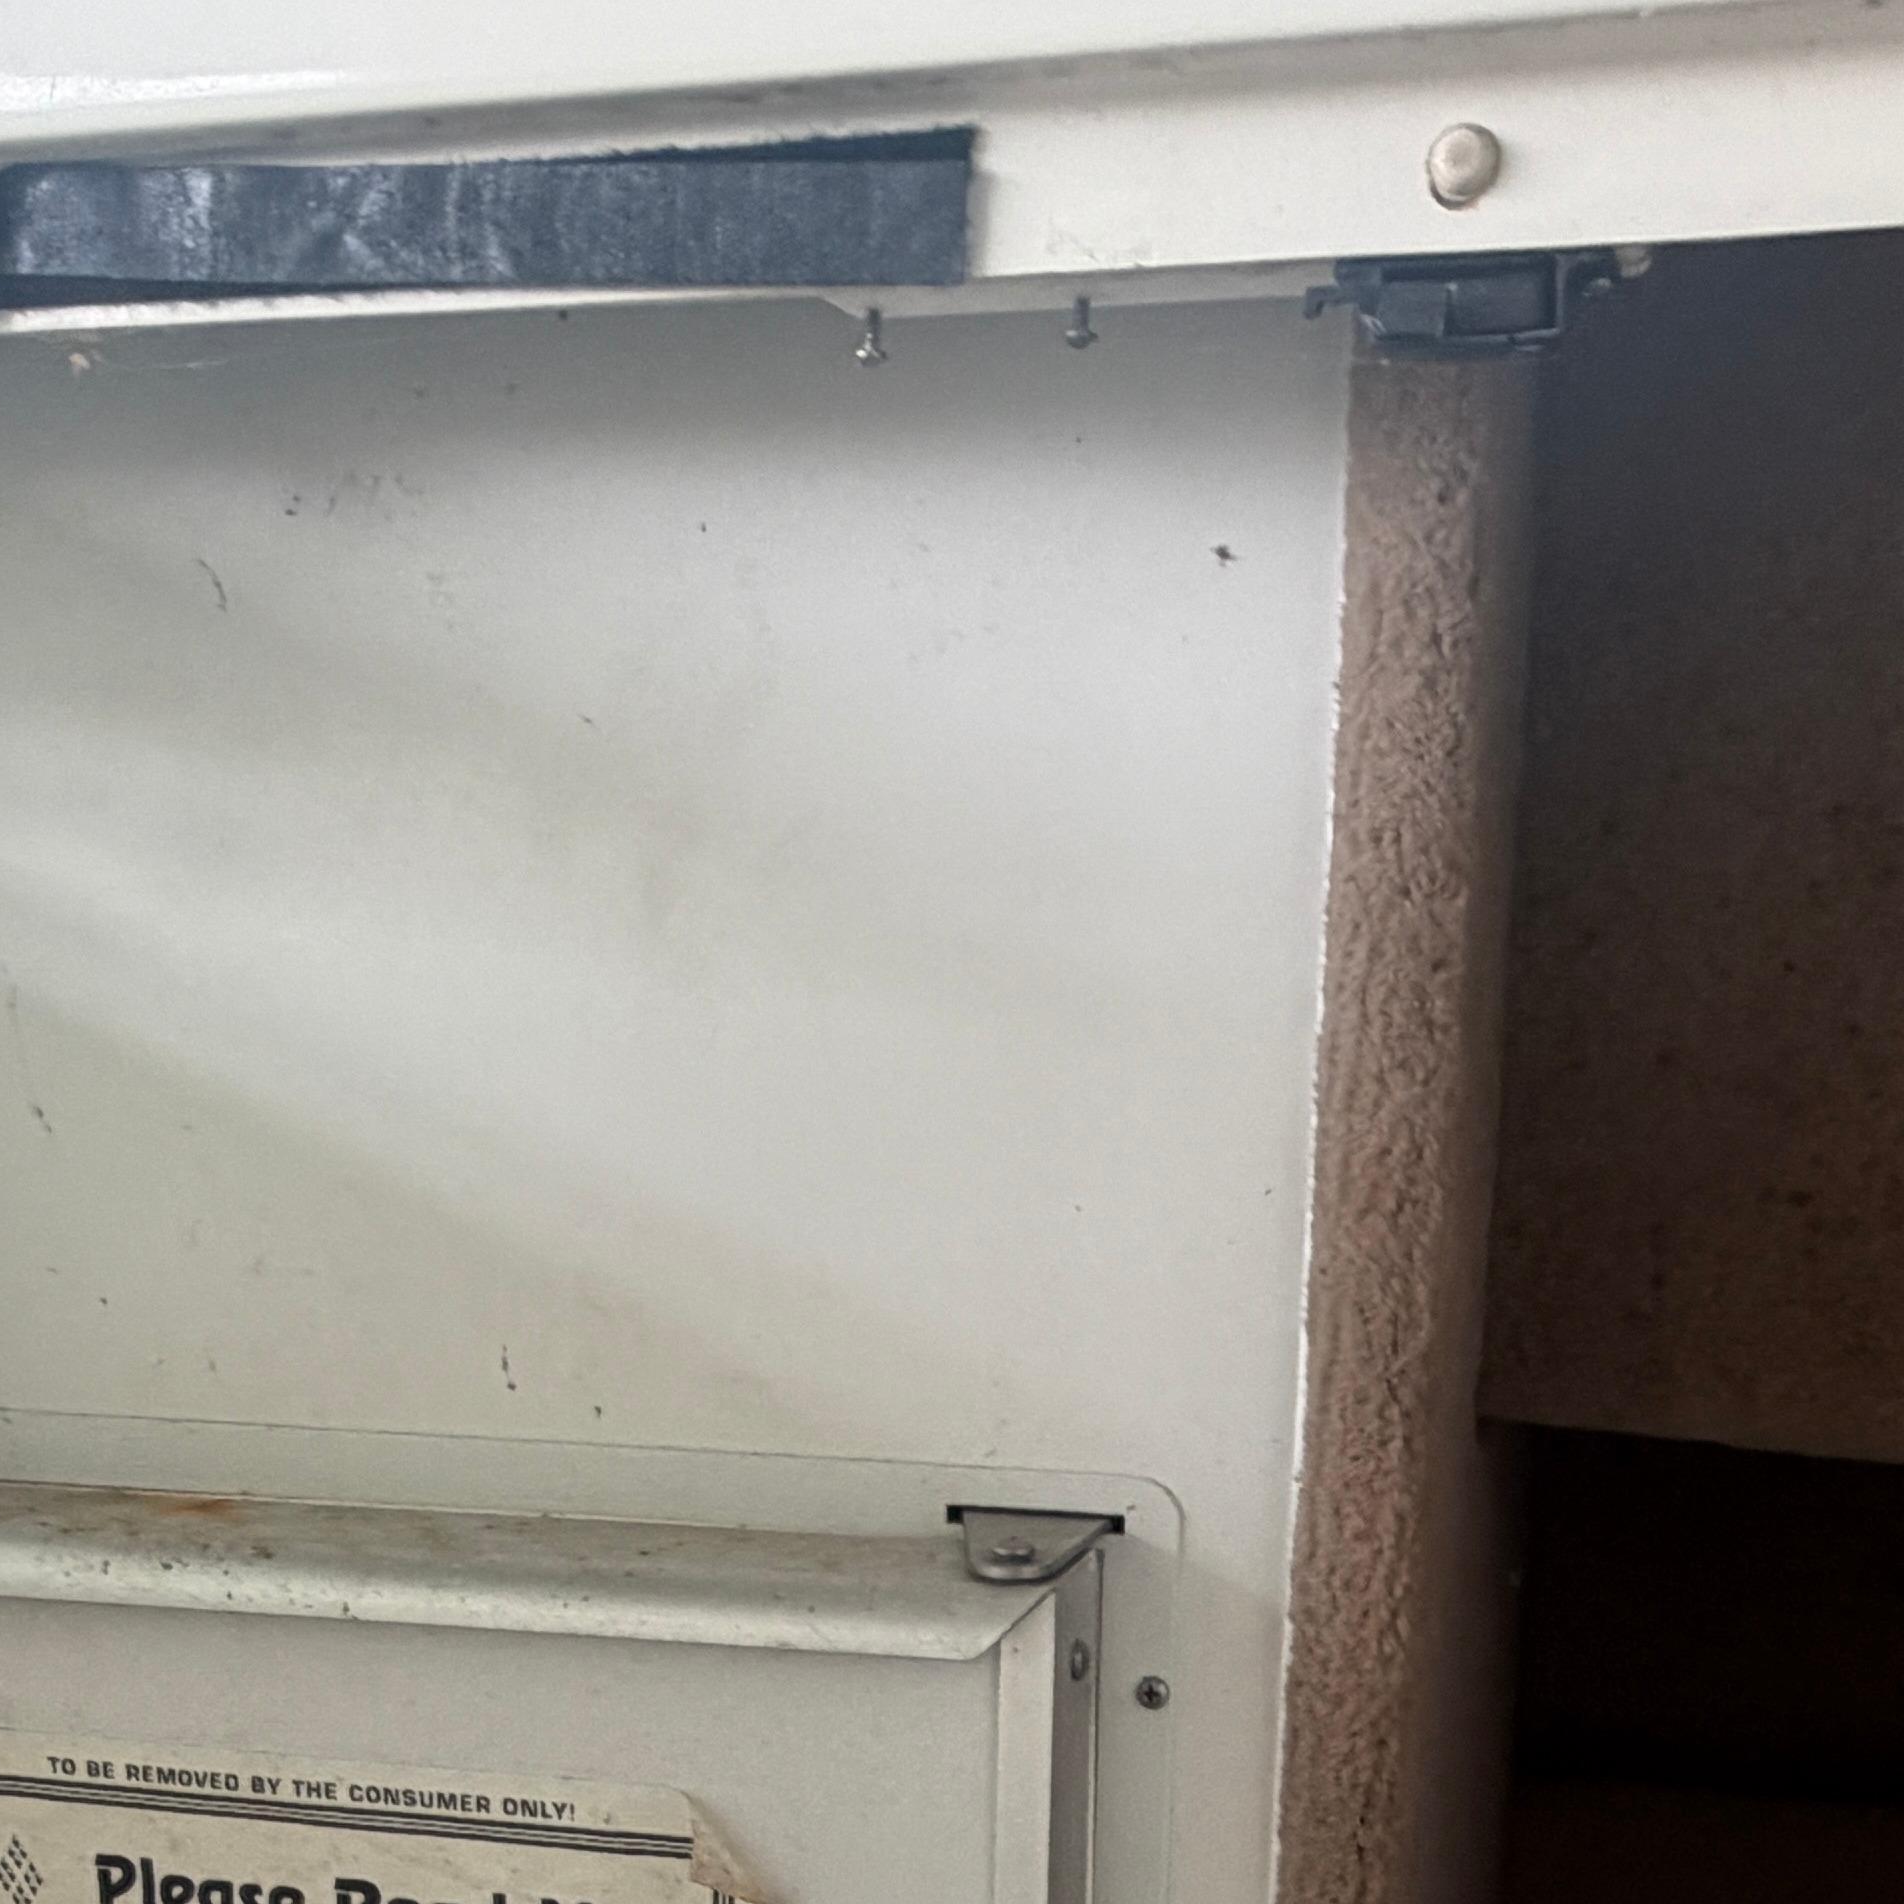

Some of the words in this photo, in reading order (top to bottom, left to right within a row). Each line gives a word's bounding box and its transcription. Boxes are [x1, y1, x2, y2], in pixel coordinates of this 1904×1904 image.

[48, 1756, 76, 1777] TO
[87, 1760, 115, 1781] BE
[125, 1763, 239, 1792] REMOVED
[251, 1775, 282, 1796] BY
[292, 1779, 338, 1801] THE
[349, 1783, 491, 1815] CONSUMER
[502, 1797, 576, 1822] ONLY!
